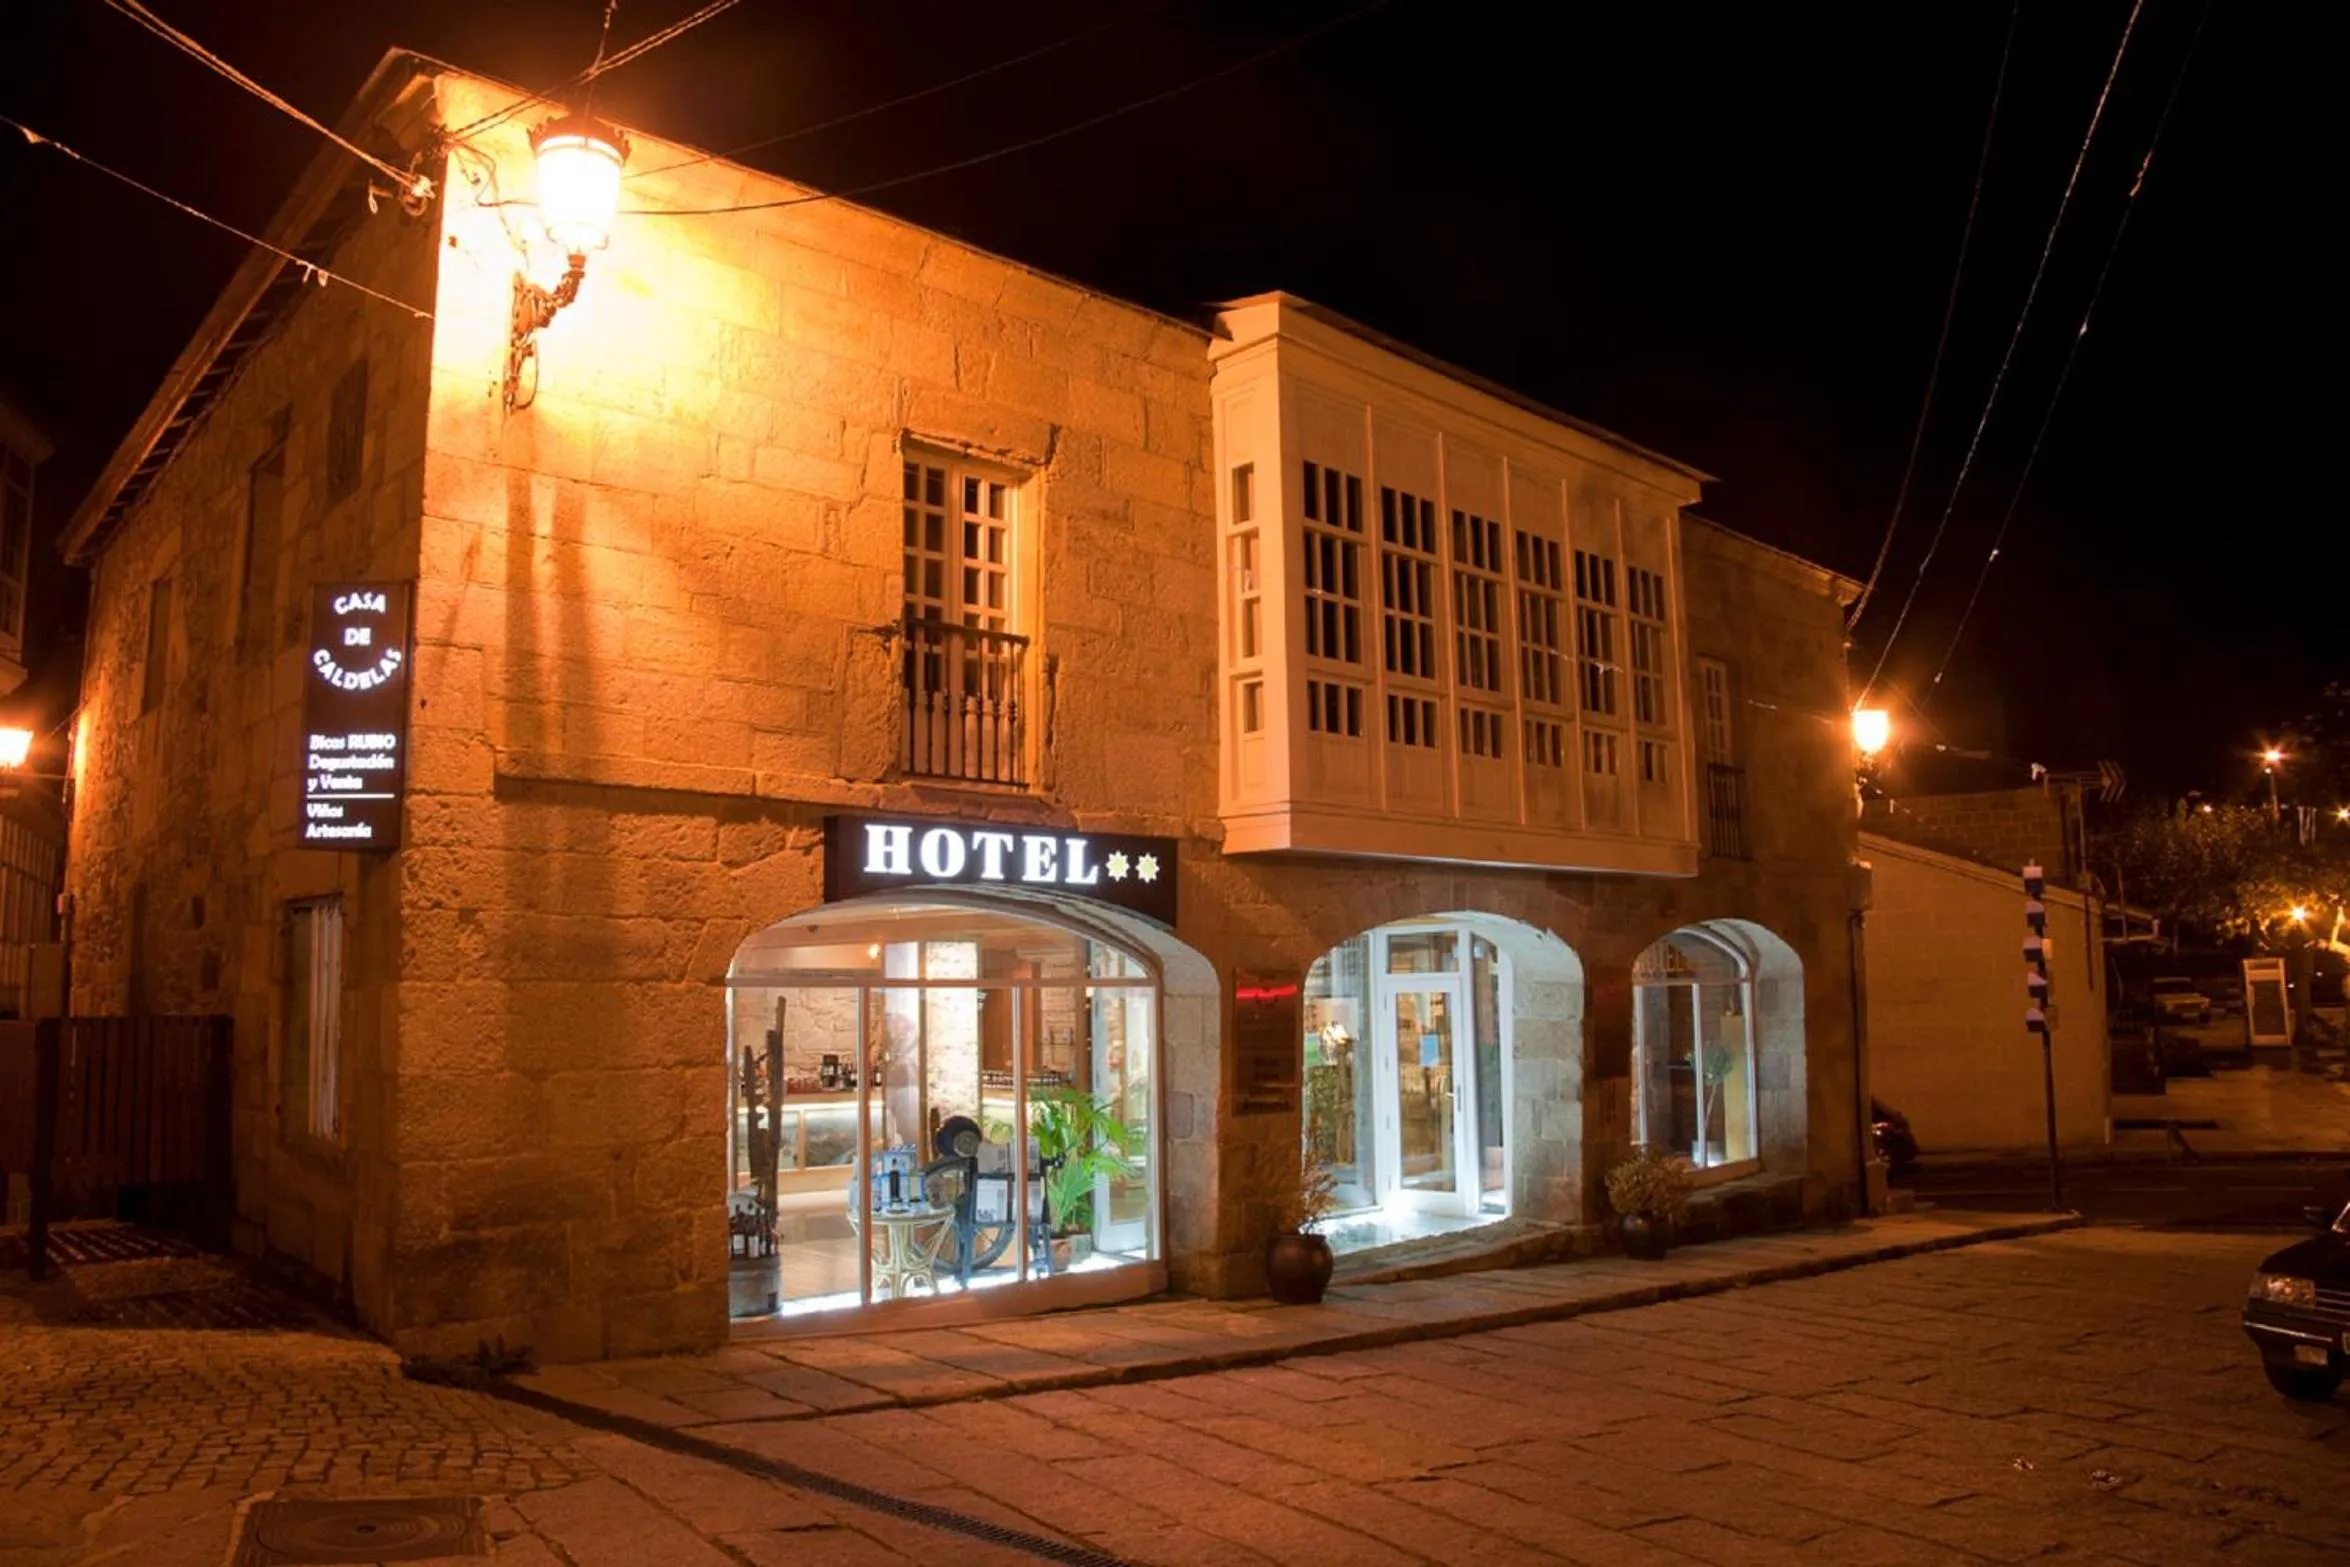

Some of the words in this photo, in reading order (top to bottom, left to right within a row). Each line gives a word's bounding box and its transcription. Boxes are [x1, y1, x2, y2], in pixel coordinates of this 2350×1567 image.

[334, 592, 386, 614] CASA
[344, 628, 371, 646] DE
[313, 648, 402, 690] CALDELAS
[308, 753, 395, 772] Degustación
[307, 778, 319, 793] y
[319, 773, 363, 790] Venta
[305, 821, 372, 838] Artesanía
[864, 824, 1099, 884] HOTEL
